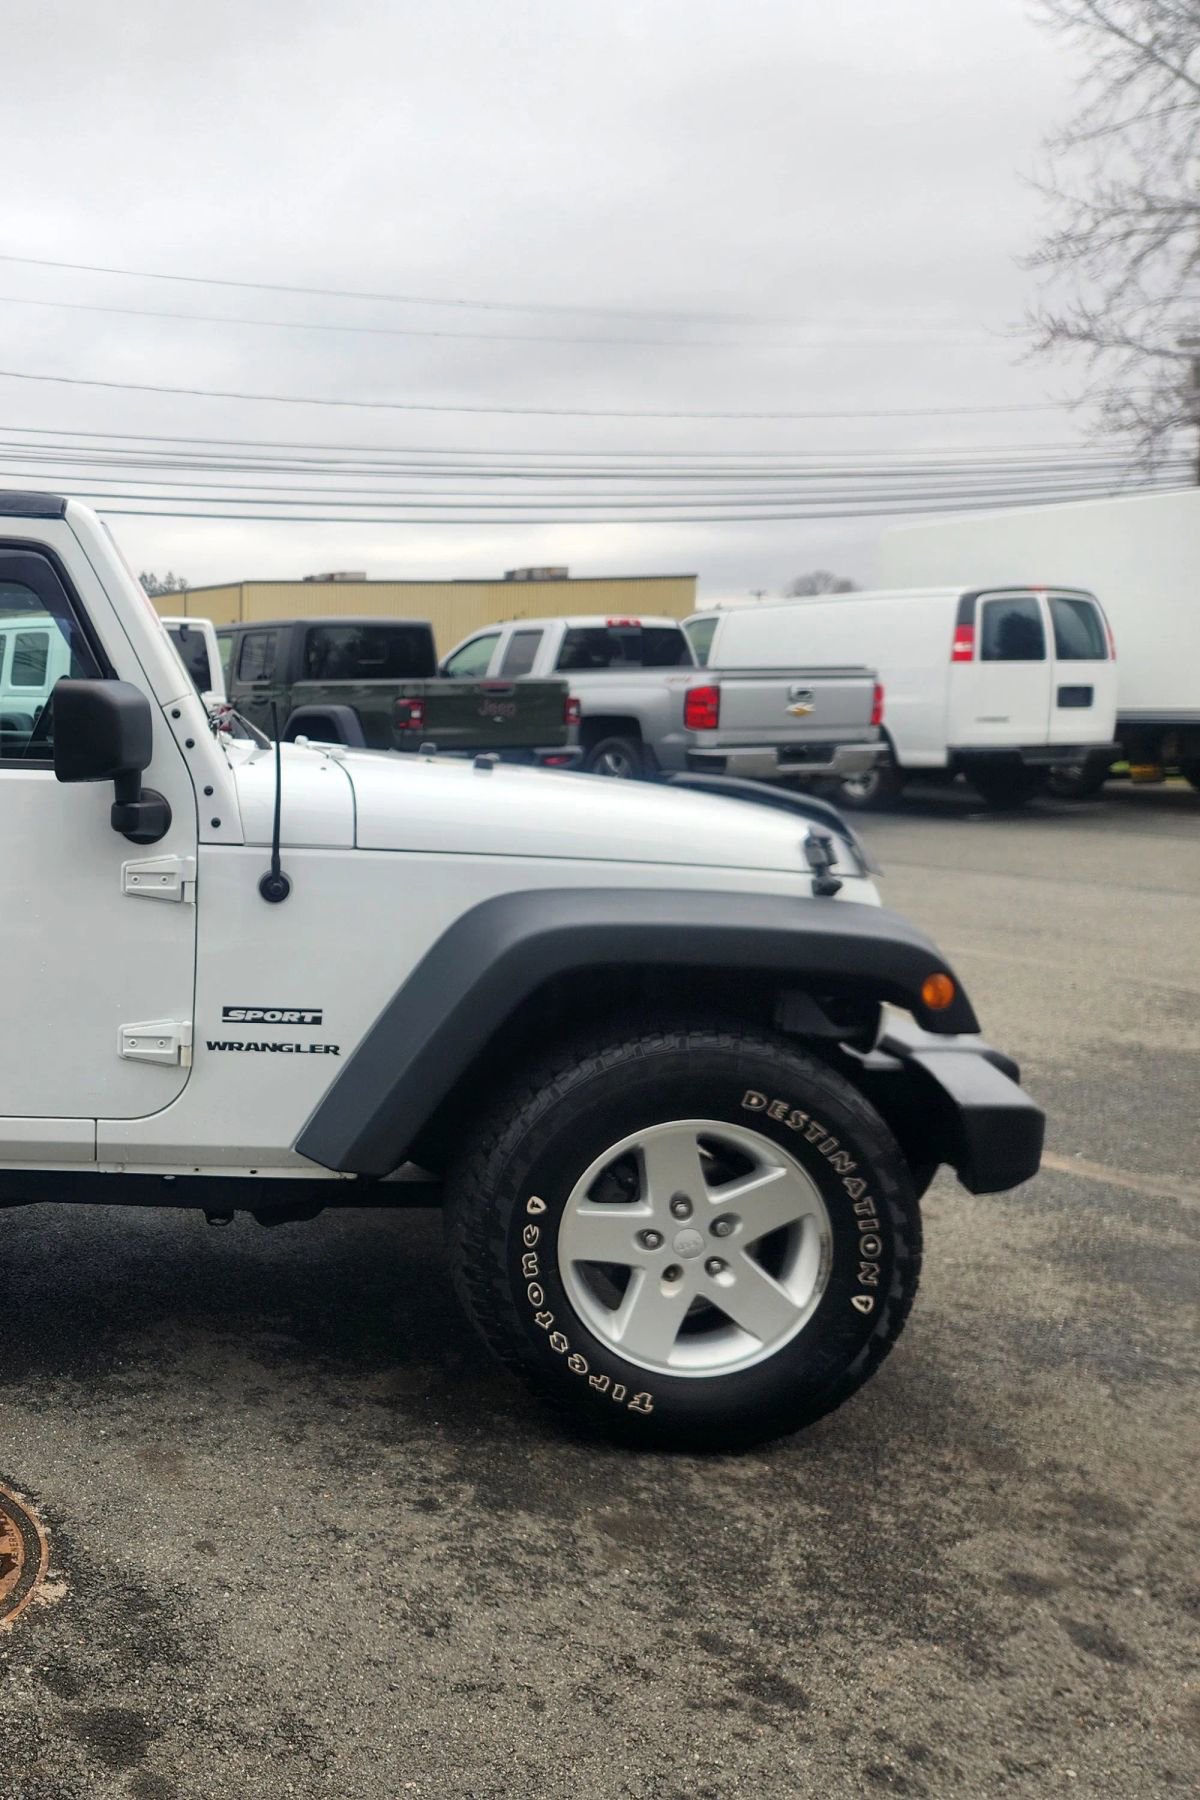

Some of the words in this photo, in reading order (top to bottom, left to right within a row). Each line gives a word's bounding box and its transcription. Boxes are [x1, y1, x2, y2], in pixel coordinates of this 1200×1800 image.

[206, 1041, 341, 1056] WRANGLER
[222, 1008, 323, 1024] SPORT
[741, 1090, 883, 1287] DESTINATION
[521, 1222, 655, 1414] Firestone
